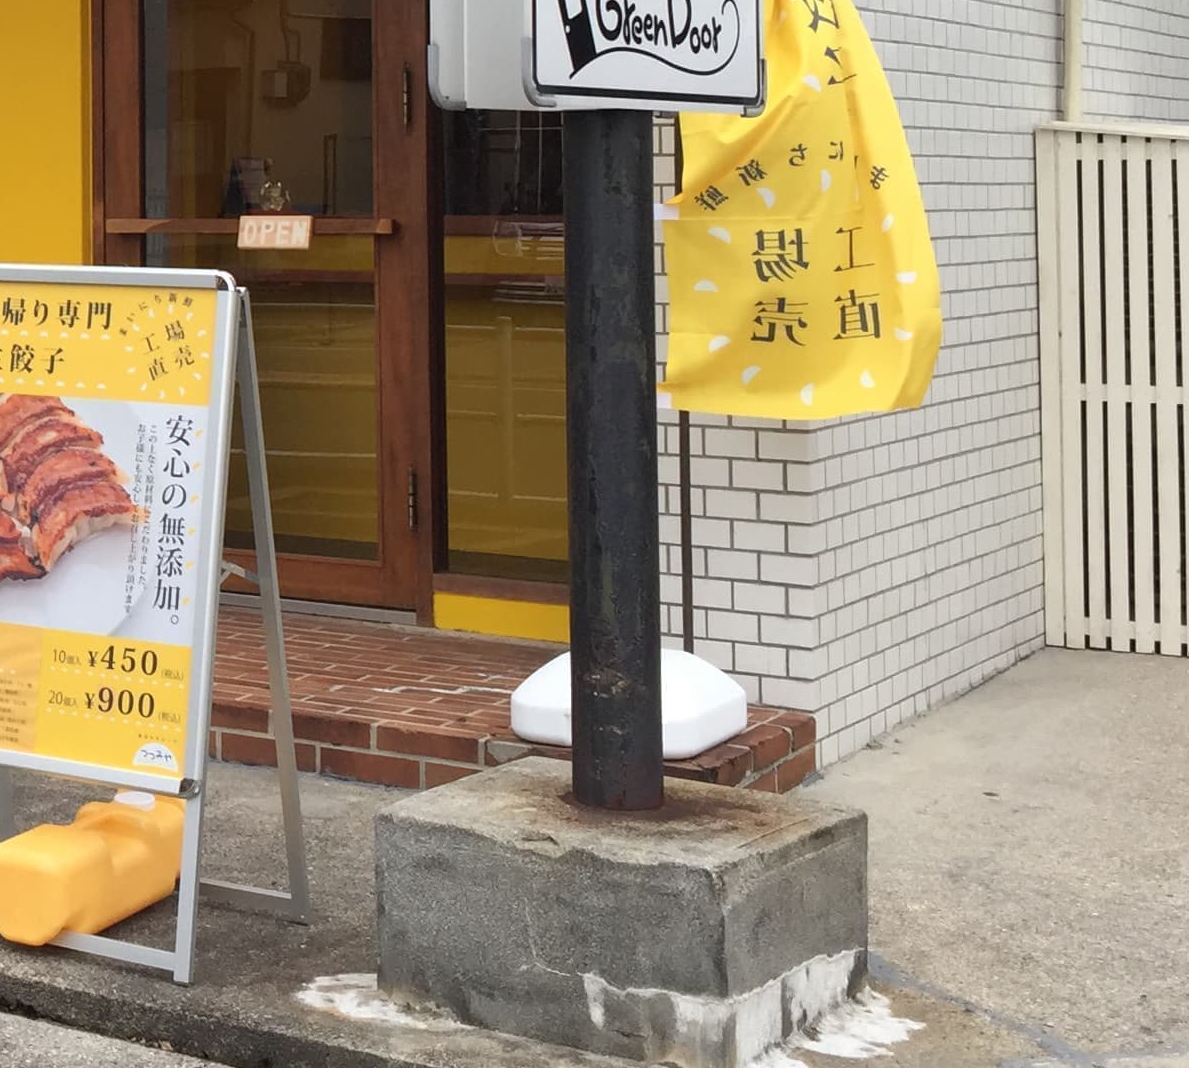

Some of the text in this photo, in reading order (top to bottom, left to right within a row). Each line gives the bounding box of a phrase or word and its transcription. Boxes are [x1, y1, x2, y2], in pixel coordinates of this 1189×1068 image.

[243, 219, 309, 246] OPEN
[152, 414, 194, 625] 安心の無添加。
[87, 645, 159, 676] ¥450
[84, 686, 156, 719] ¥900
